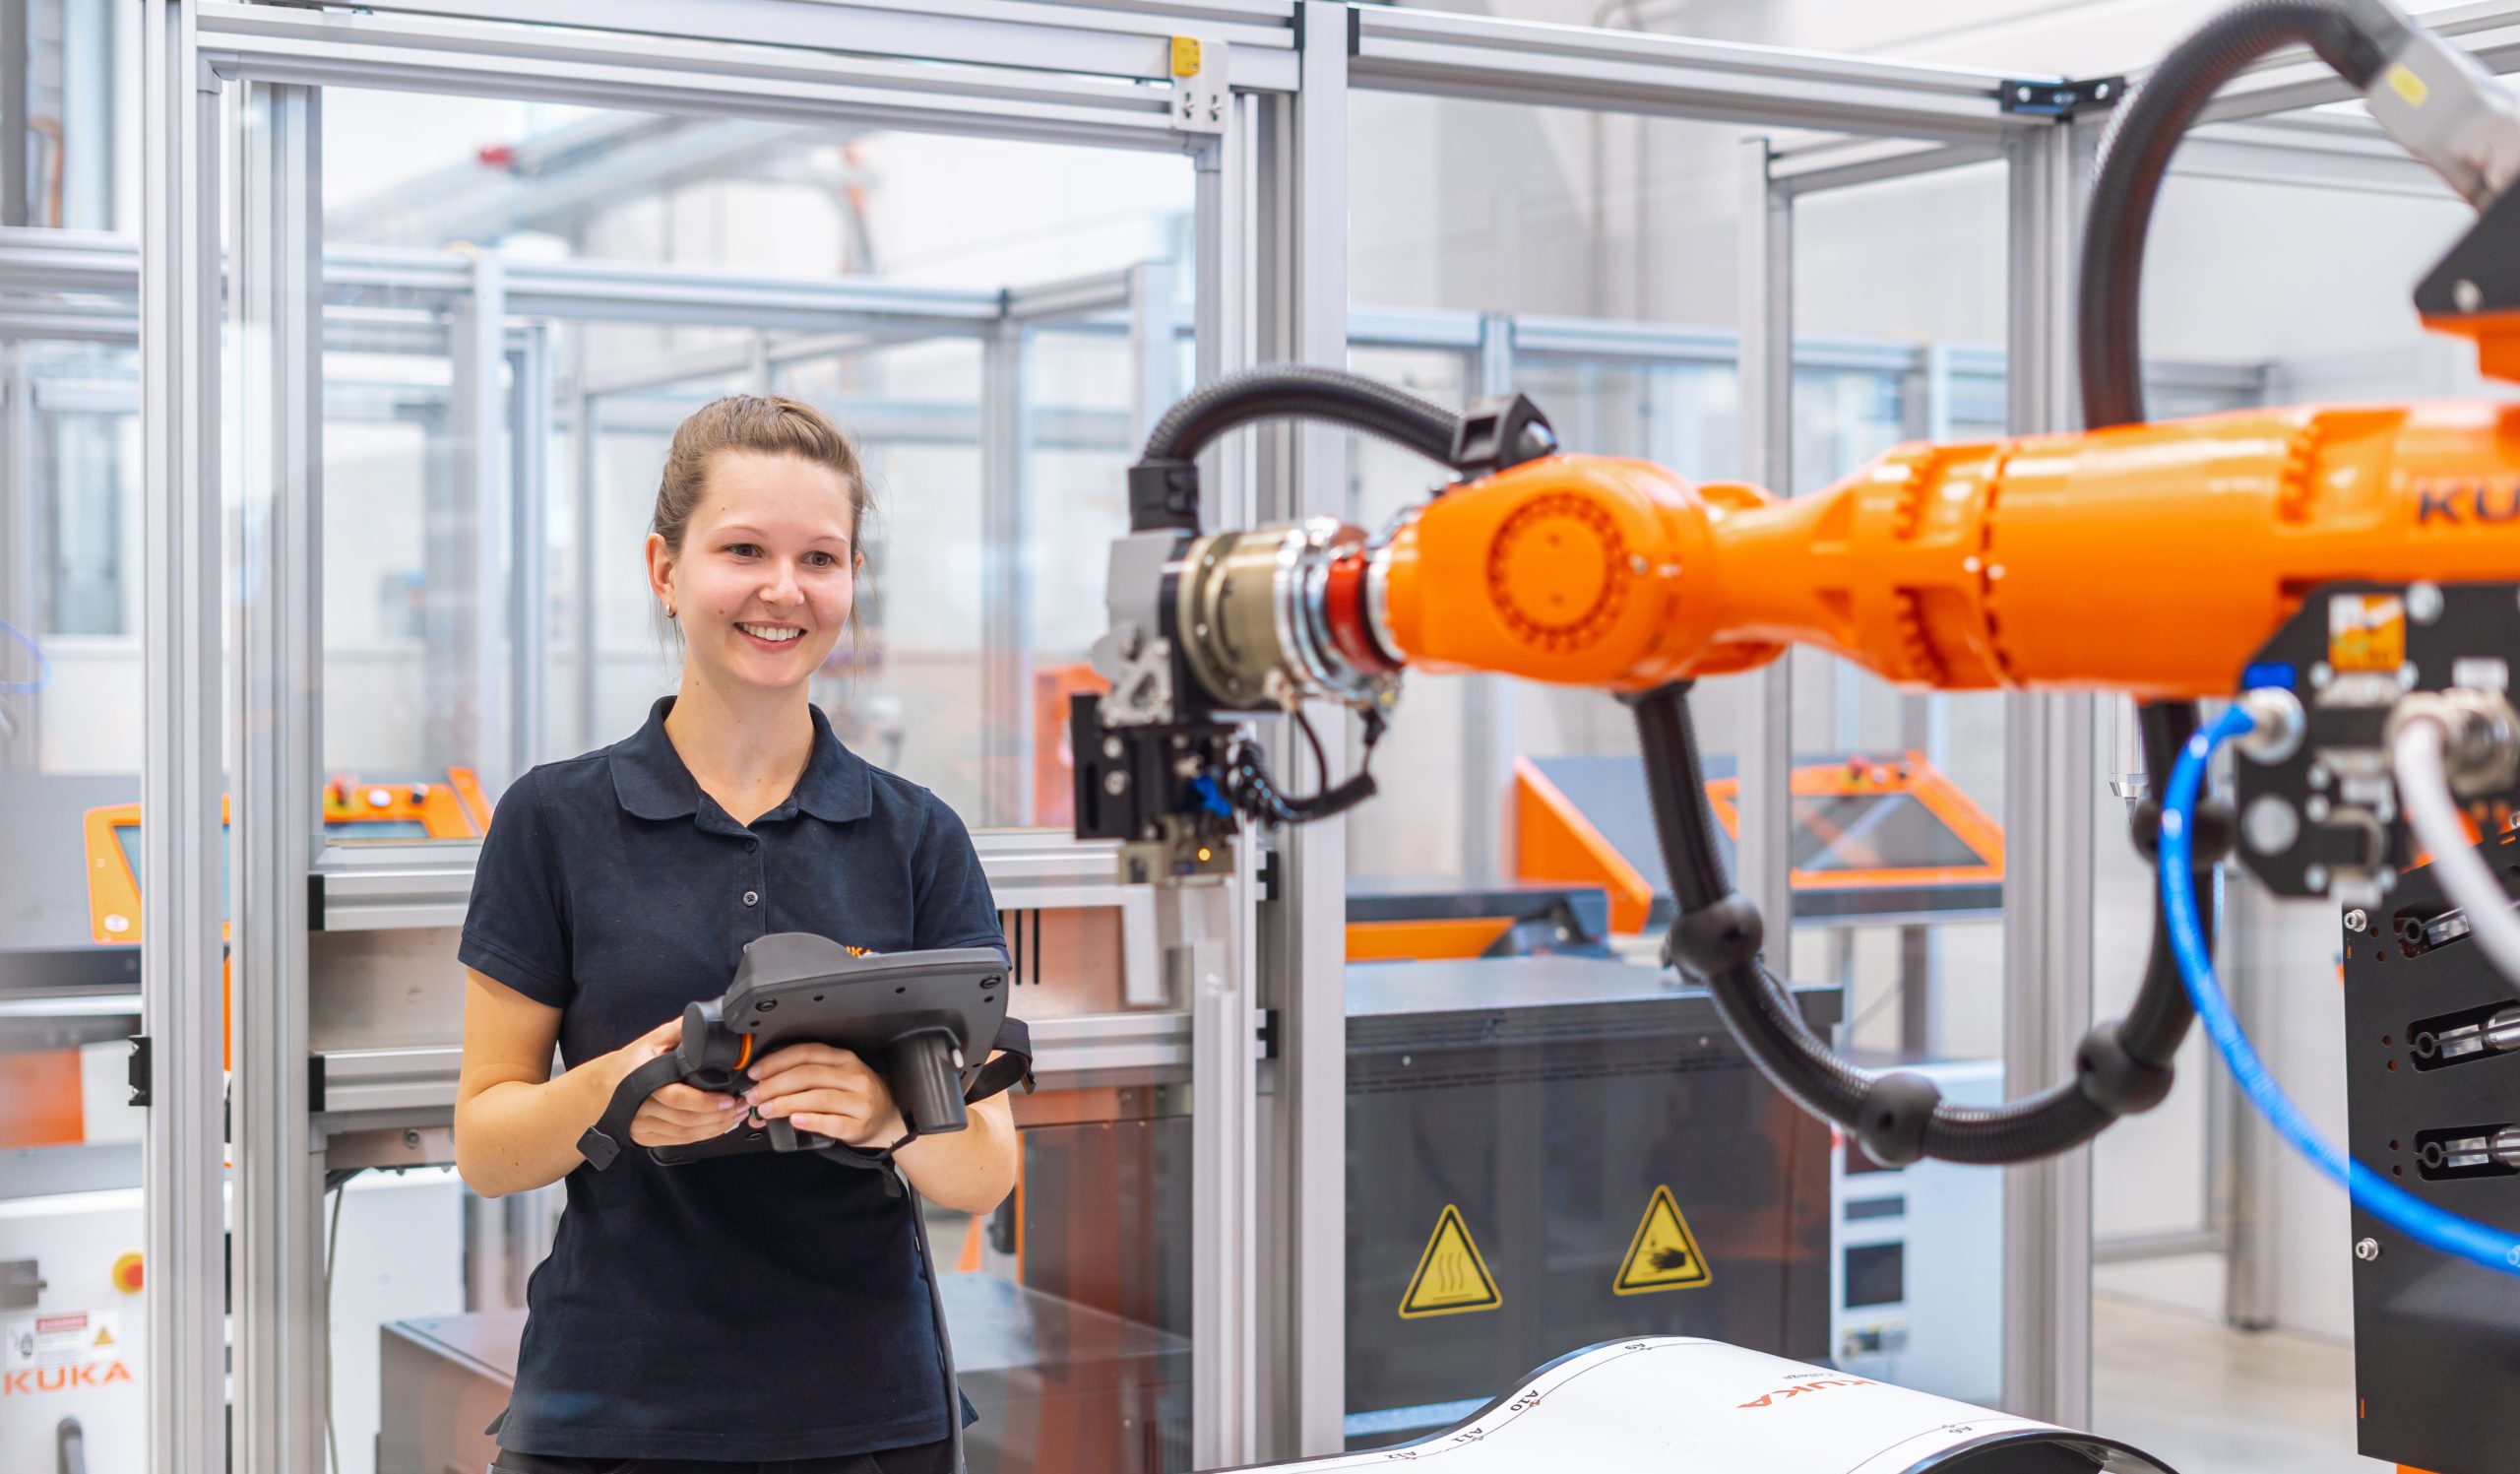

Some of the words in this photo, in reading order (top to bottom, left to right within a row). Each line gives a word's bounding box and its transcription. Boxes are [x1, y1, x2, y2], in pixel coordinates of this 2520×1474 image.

[4, 1361, 132, 1396] KUKA
[1510, 1389, 1539, 1412] A10
[1735, 1379, 1879, 1408] KUKA
[1451, 1427, 1483, 1443] A11
[1385, 1450, 1417, 1459] A12
